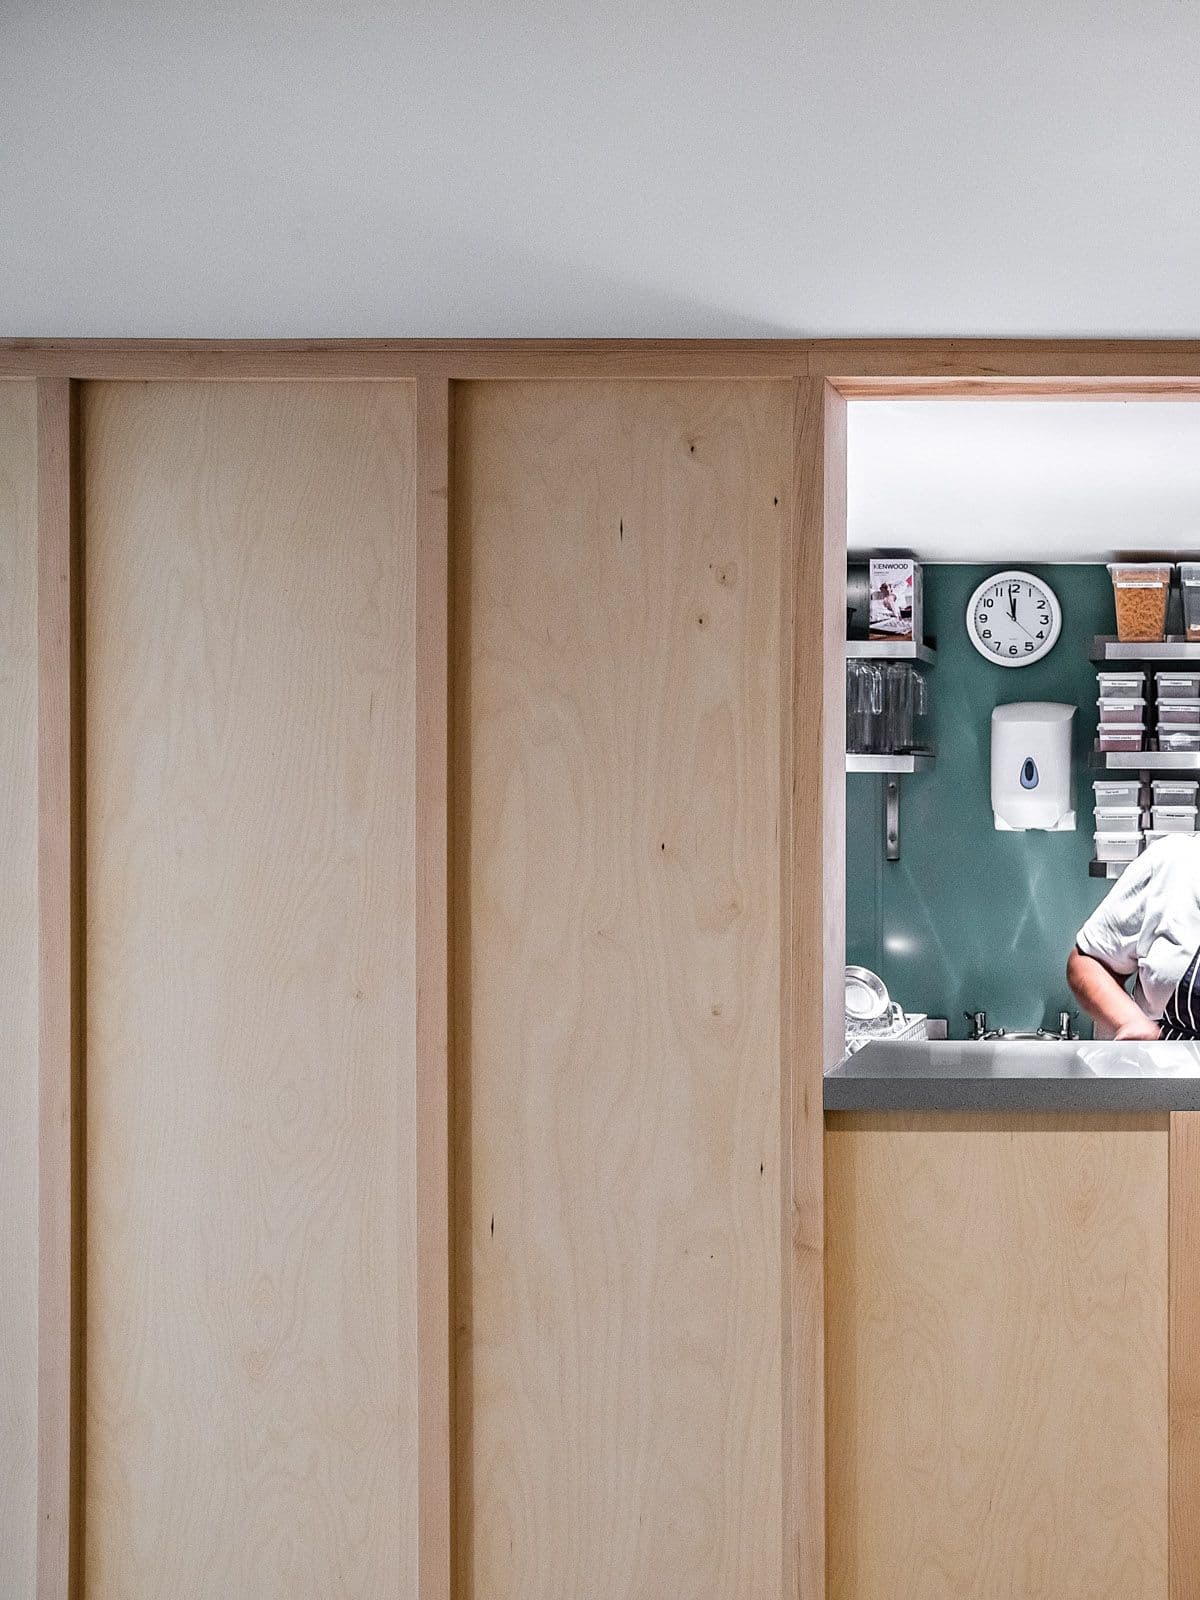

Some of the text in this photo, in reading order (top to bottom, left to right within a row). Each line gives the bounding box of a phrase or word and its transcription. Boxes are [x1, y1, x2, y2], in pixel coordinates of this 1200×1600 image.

[996, 587, 1003, 597] 11
[1028, 588, 1032, 598] 1
[983, 598, 994, 608] 10
[1036, 600, 1046, 609] 2
[979, 613, 988, 623] 9
[1039, 614, 1049, 625] 3
[982, 629, 992, 638] 8
[1035, 630, 1045, 640] 4
[994, 641, 1001, 651] 7
[1008, 645, 1018, 655] 6
[1024, 641, 1034, 651] 5
